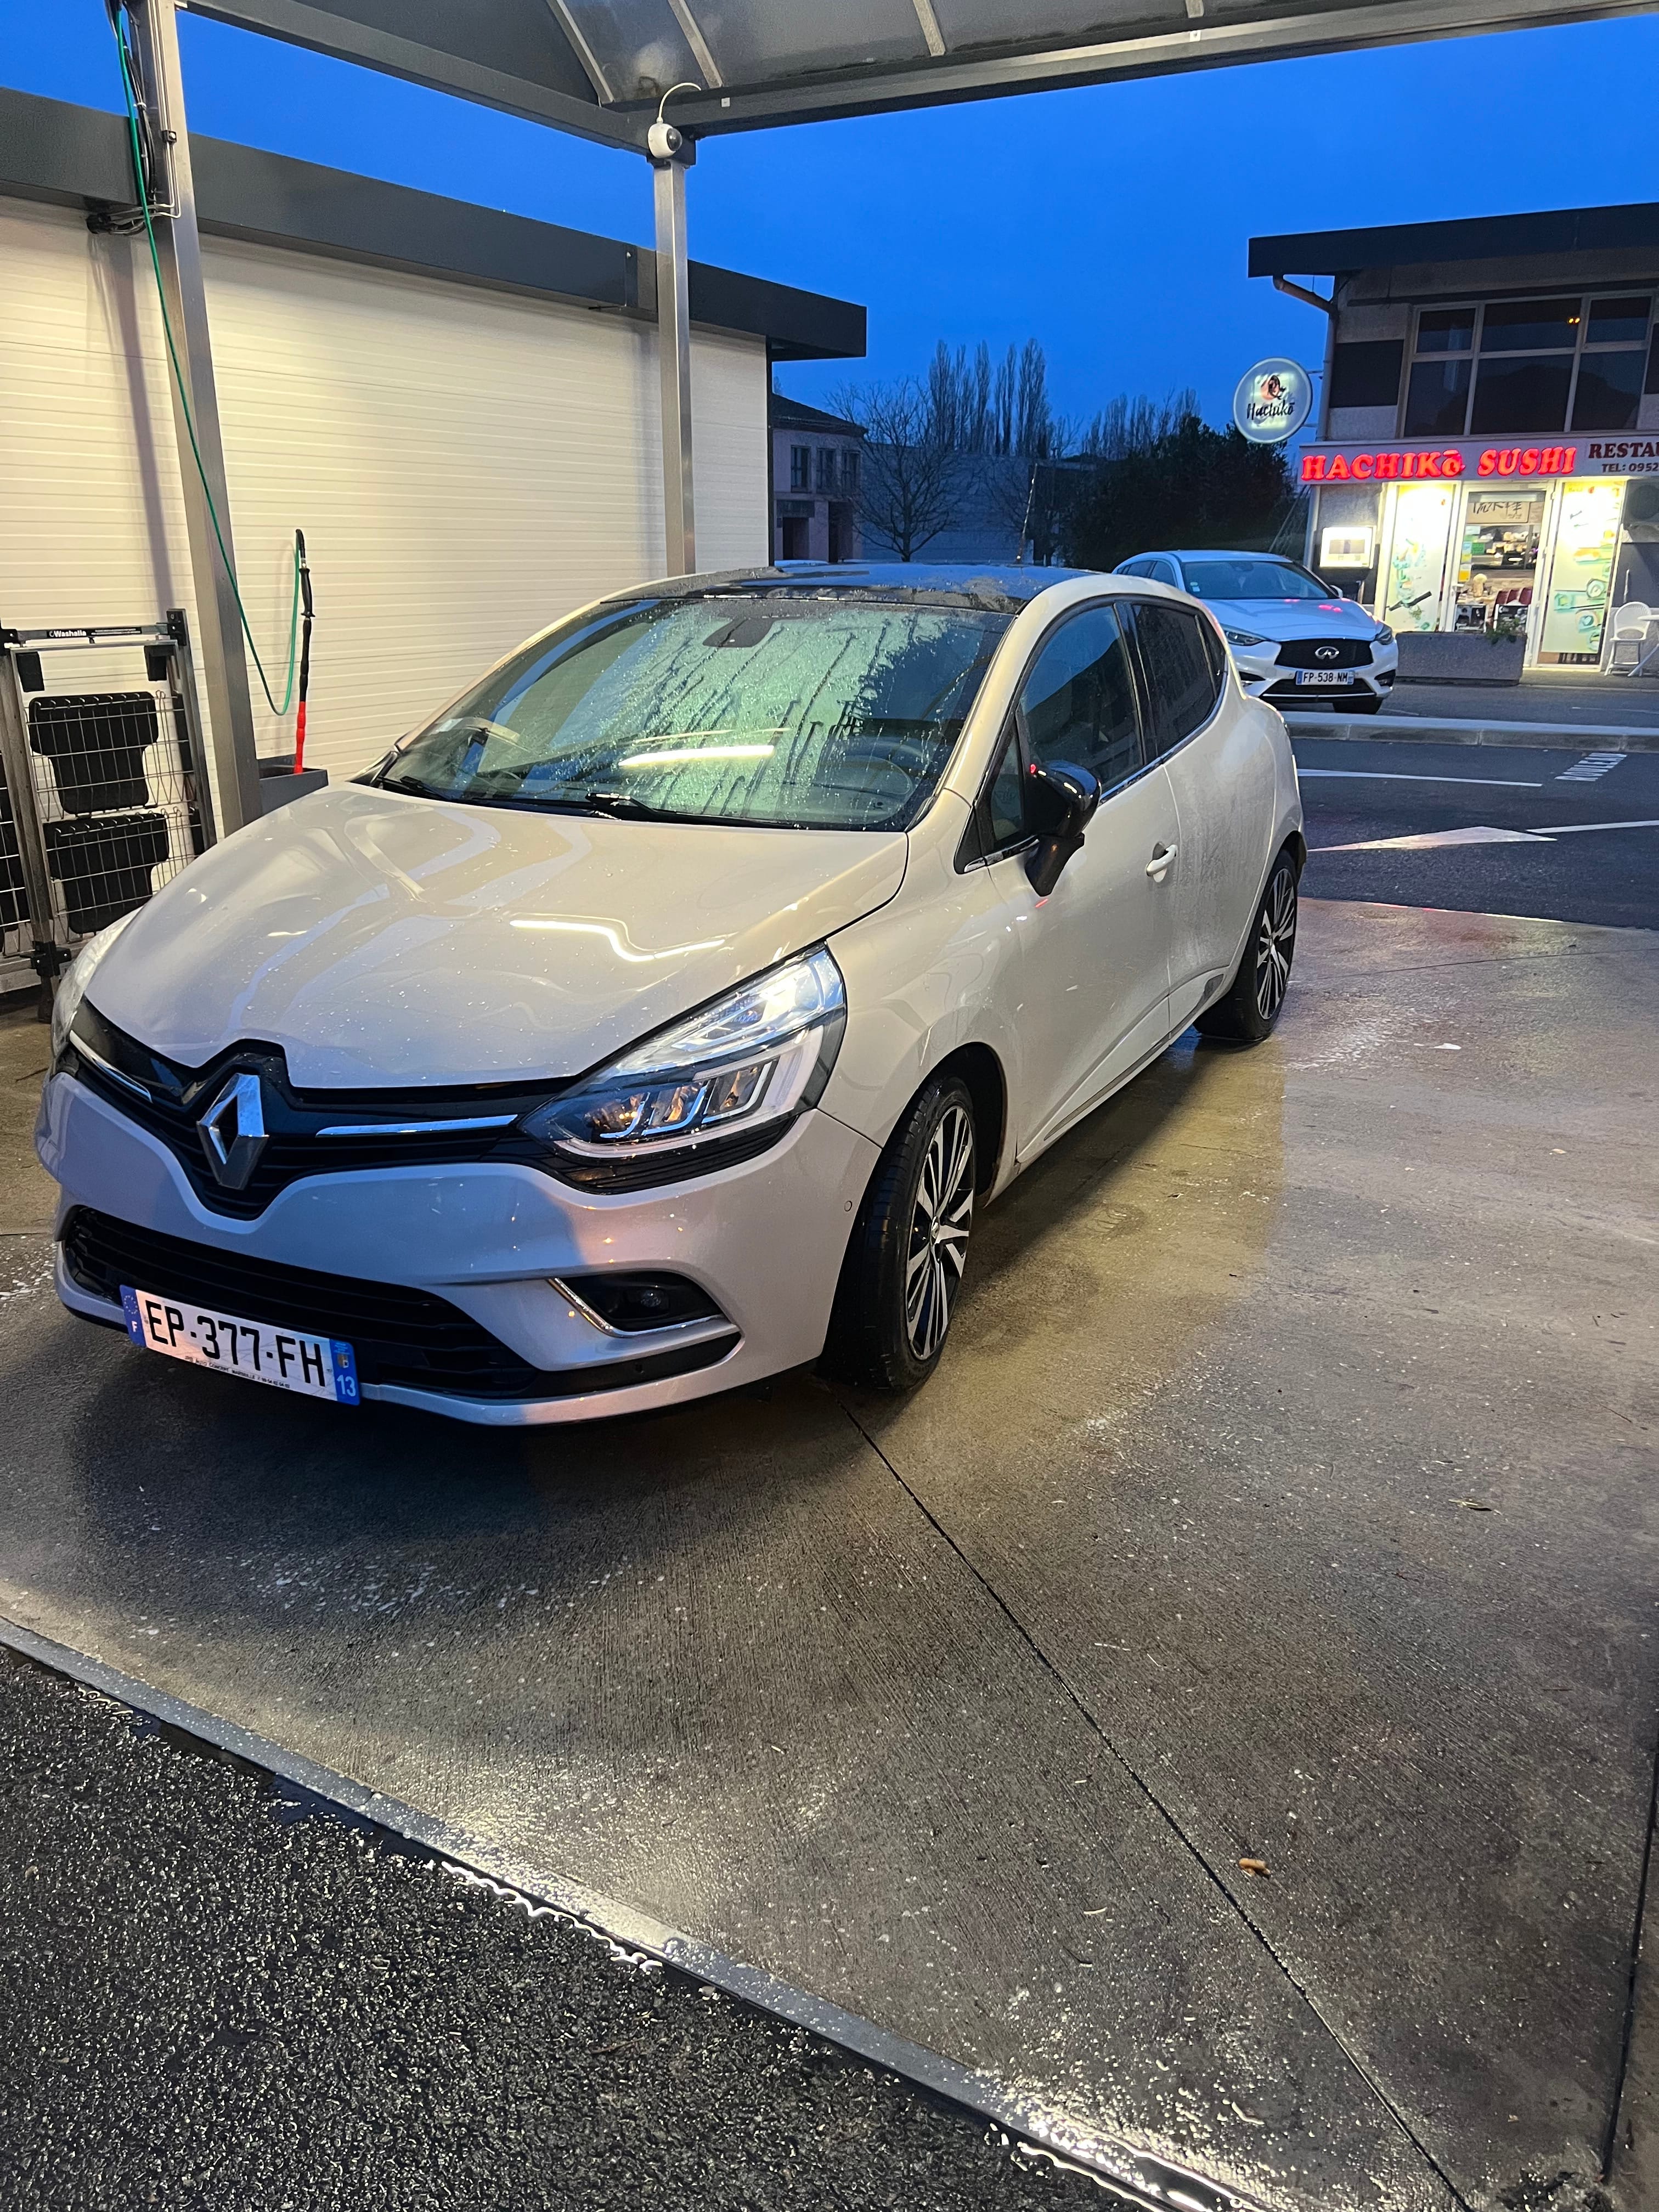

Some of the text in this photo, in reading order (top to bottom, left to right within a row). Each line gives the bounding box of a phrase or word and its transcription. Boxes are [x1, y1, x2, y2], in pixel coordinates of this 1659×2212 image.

[1477, 446, 1576, 476] SUSHI
[1602, 464, 1626, 472] TEL:
[131, 1321, 137, 1332] F
[337, 1374, 356, 1397] 13
